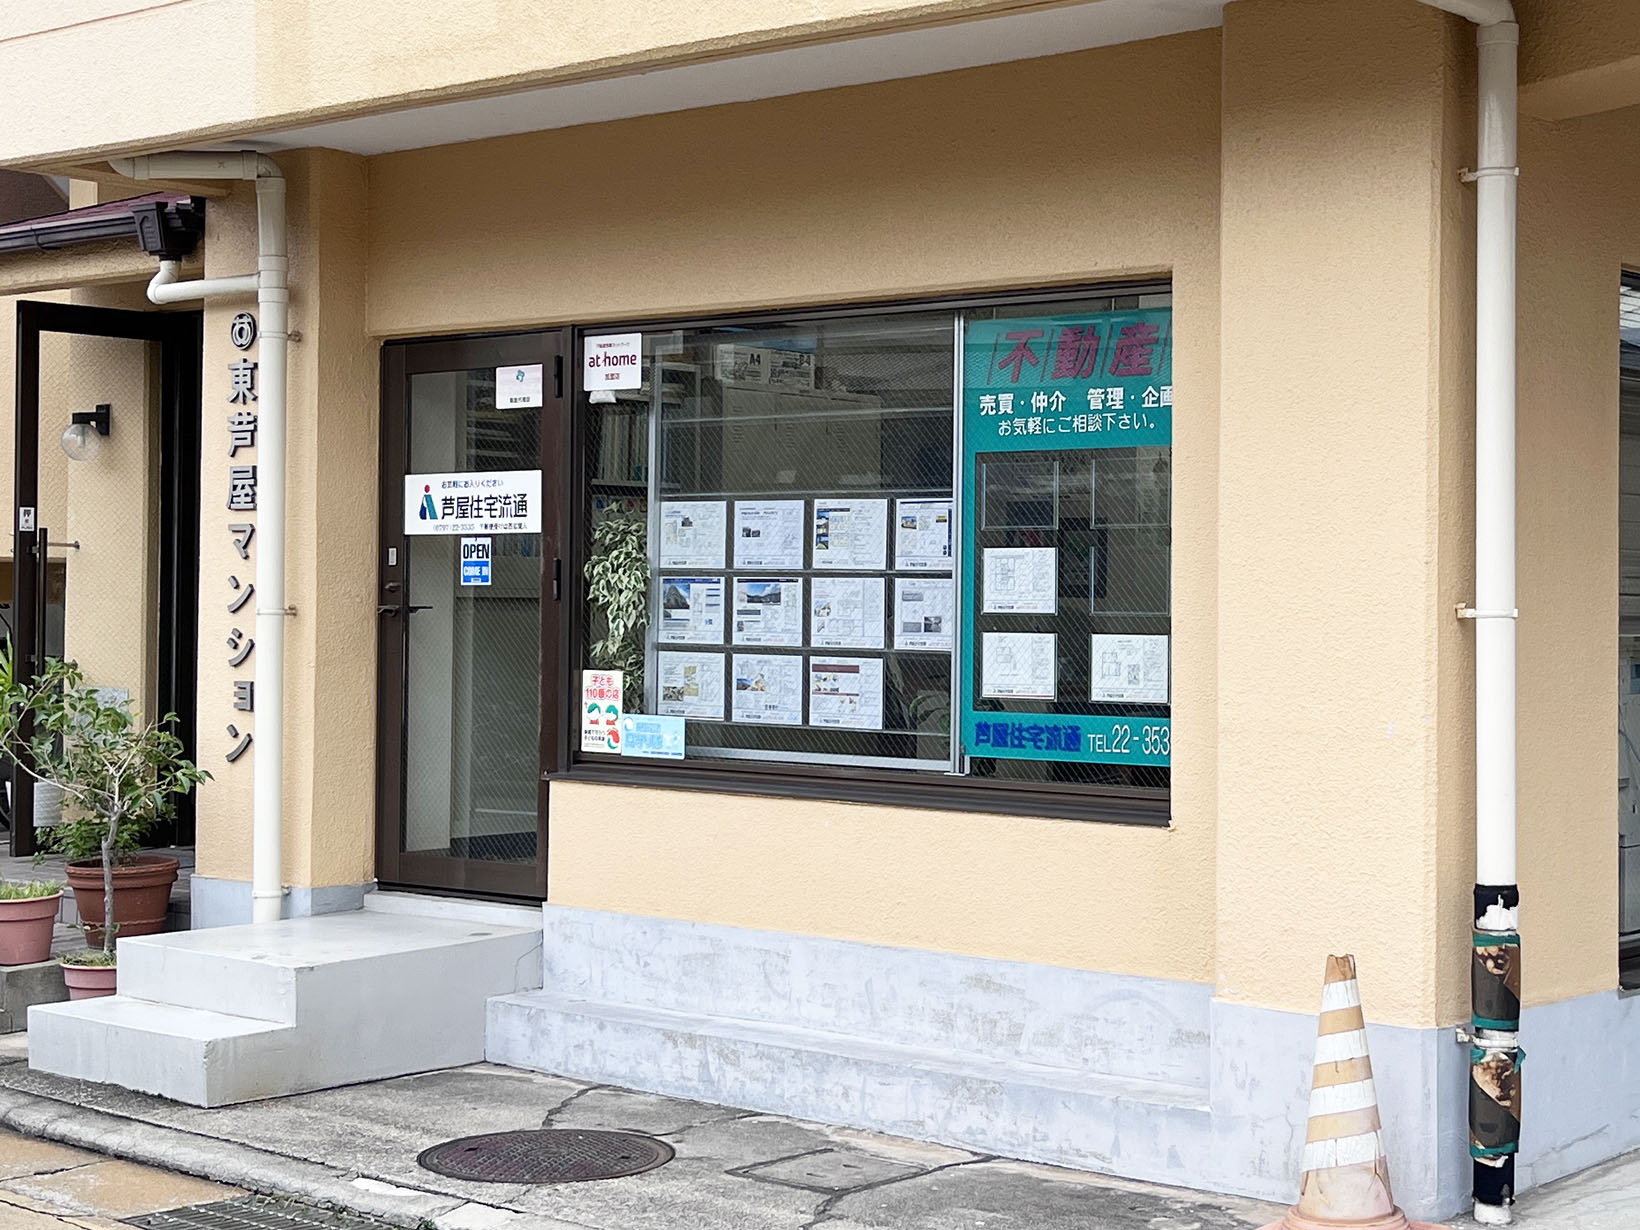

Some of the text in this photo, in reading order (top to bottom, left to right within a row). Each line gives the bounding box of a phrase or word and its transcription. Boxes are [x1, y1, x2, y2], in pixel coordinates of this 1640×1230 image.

[588, 350, 637, 368] at home
[998, 322, 1159, 383] 不動産
[998, 413, 1155, 436] お気軽にご相談下さい。
[440, 493, 528, 520] 芦屋住宅流通
[226, 359, 259, 763] 東芦屋マンション
[463, 543, 490, 559] OPEN
[974, 720, 1082, 753] 芦屋住宅流通
